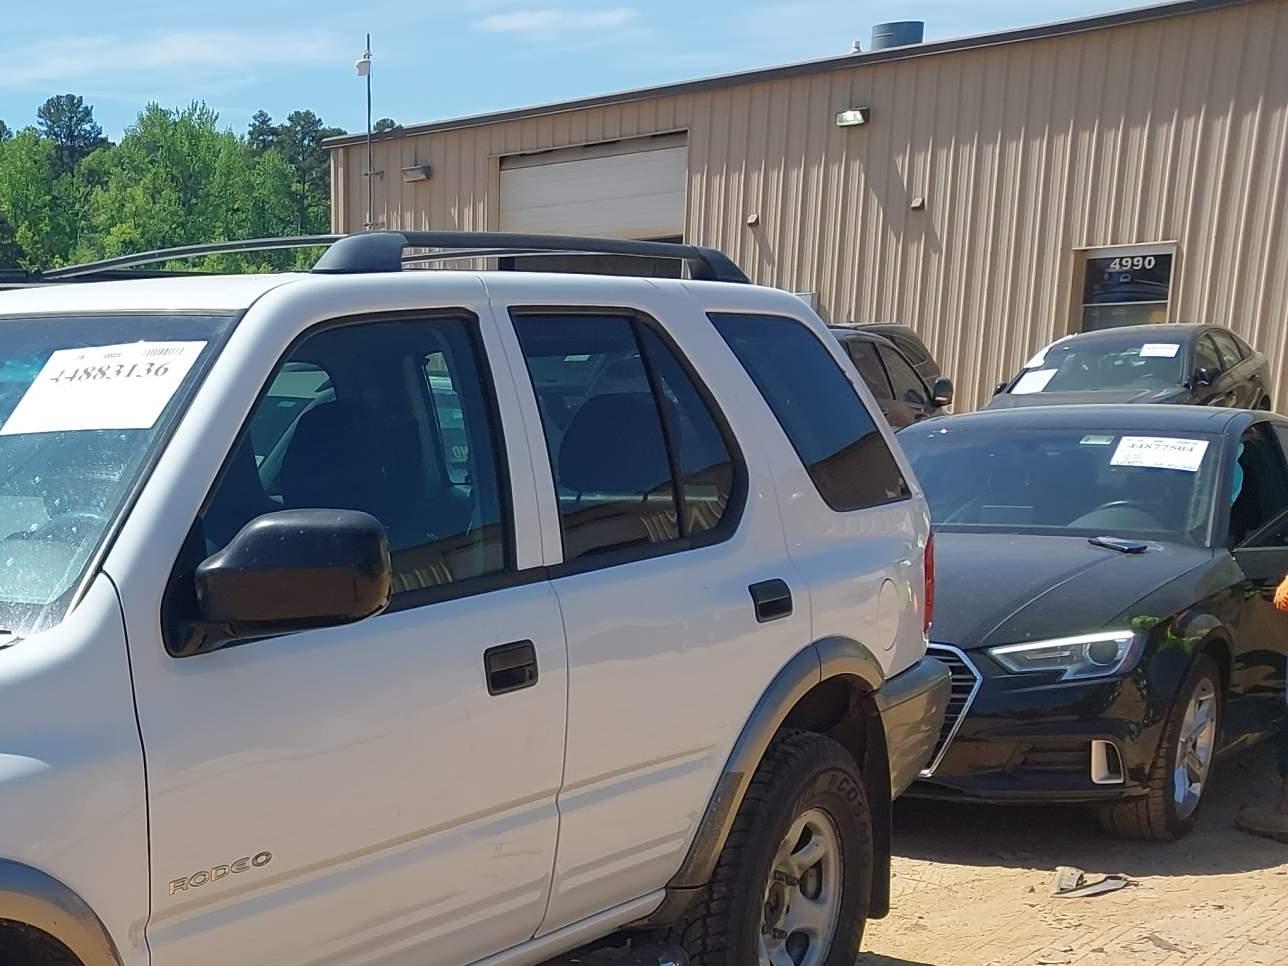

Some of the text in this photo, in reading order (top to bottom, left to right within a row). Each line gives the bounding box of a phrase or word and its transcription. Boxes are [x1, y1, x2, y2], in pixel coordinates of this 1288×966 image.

[1110, 256, 1156, 270] 4990
[49, 361, 171, 383] 44883136
[168, 851, 273, 896] RODEO
